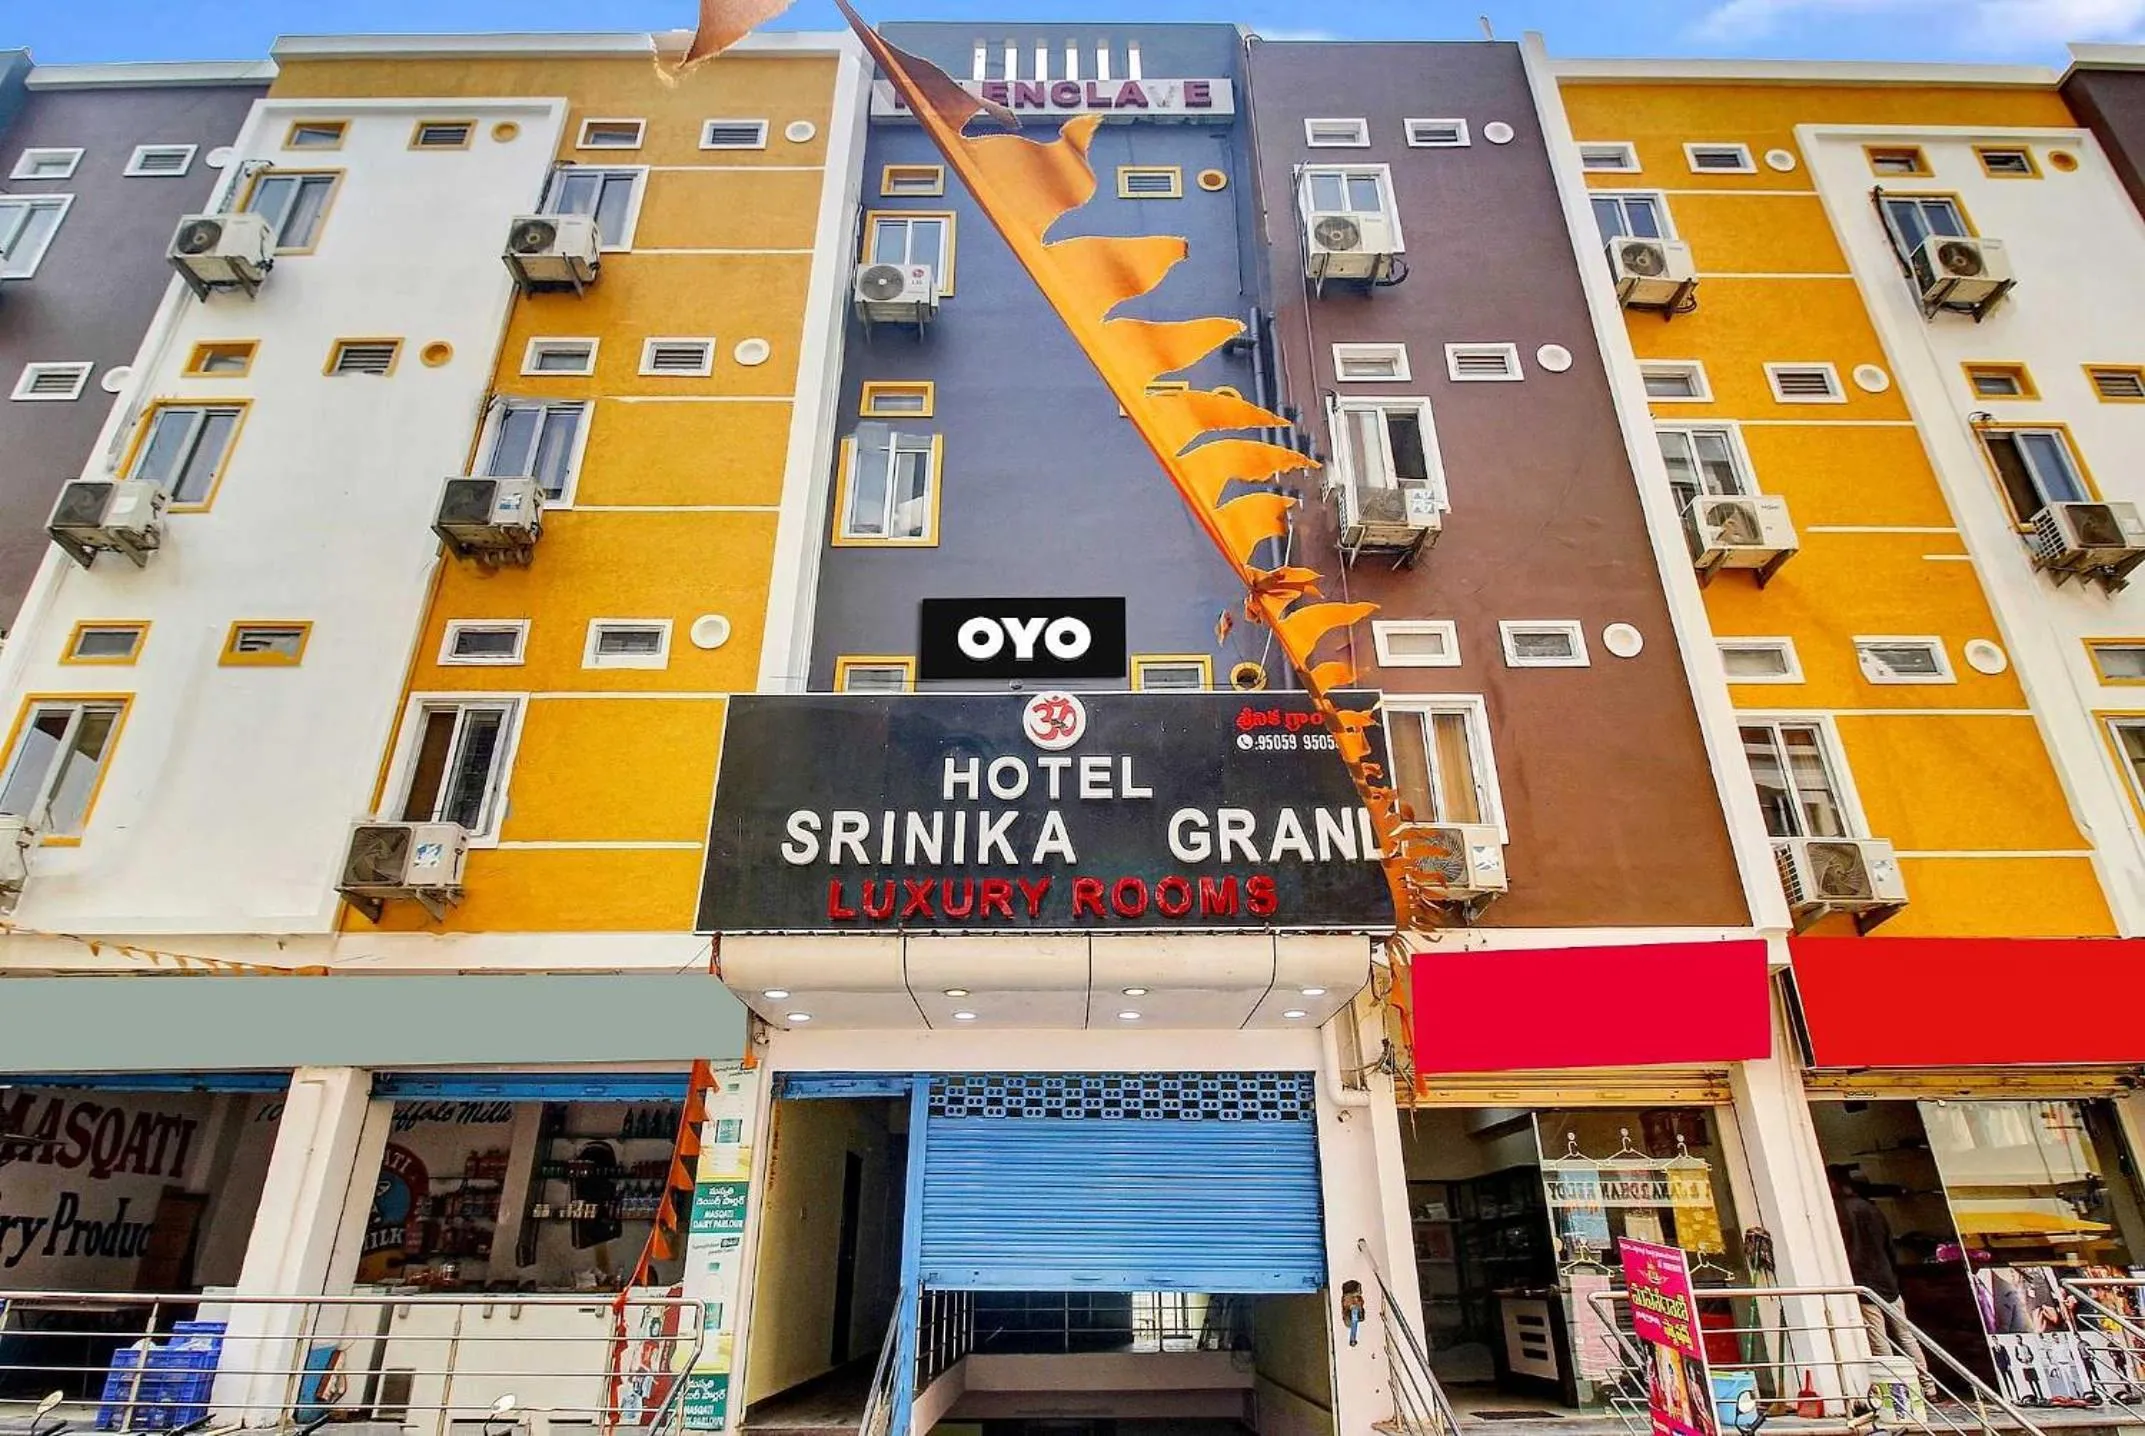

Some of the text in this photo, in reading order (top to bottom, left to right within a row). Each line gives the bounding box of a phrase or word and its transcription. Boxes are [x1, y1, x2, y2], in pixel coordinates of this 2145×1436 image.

[957, 616, 1092, 662] OYO
[1303, 734, 1339, 750] 9505
[942, 755, 1154, 801] HOTEL
[780, 807, 1079, 866] SRINIKA
[827, 875, 1280, 920] LUXURY ROOMS
